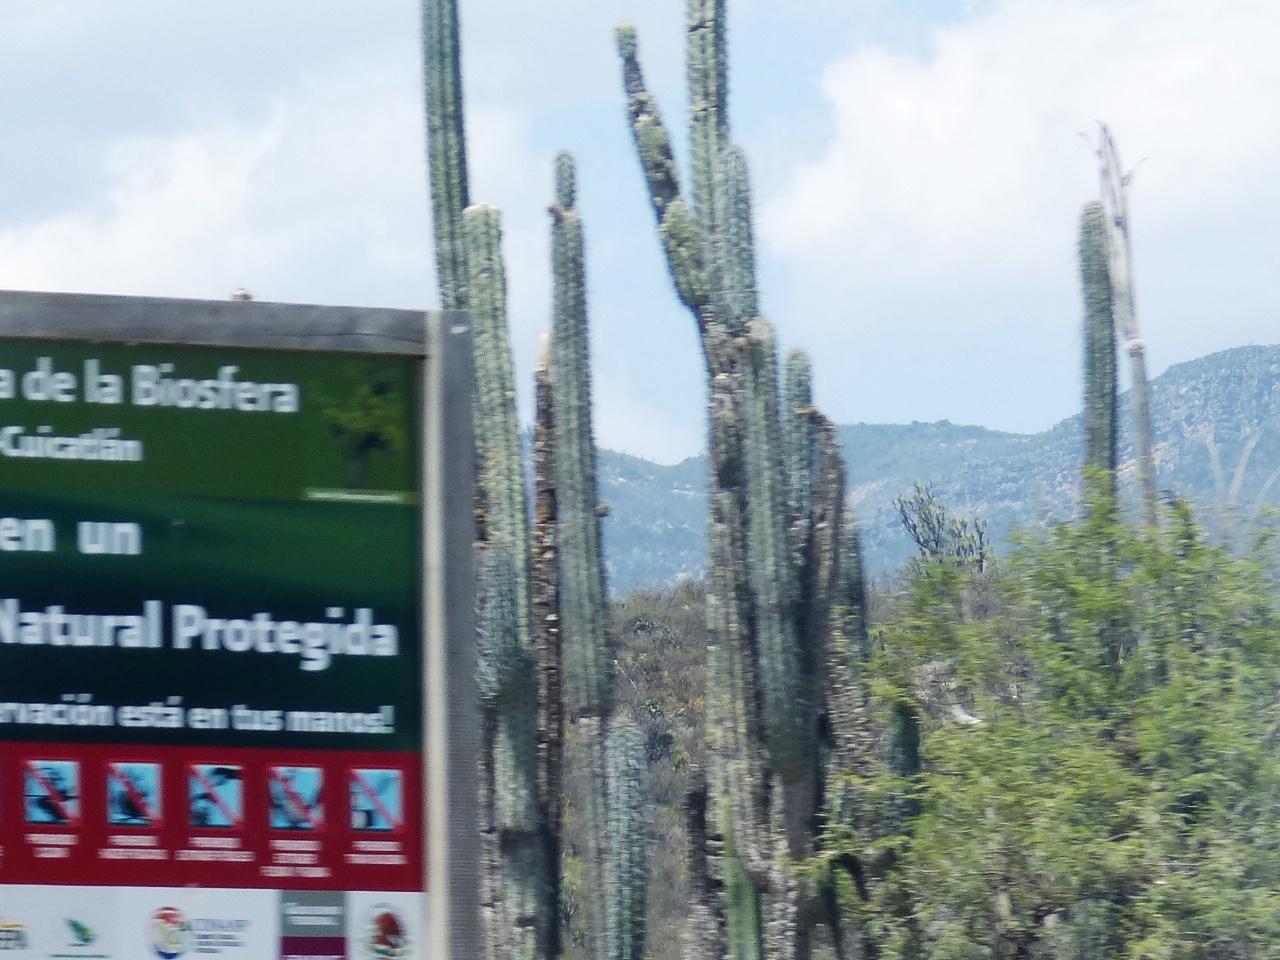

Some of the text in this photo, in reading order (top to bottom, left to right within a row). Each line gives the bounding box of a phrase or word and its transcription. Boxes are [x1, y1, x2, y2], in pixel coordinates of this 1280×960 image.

[22, 356, 78, 401] de
[82, 358, 122, 404] la
[131, 362, 300, 412] Biosfera
[77, 521, 142, 554] un
[172, 604, 399, 671] Protegida
[118, 696, 185, 728] está
[188, 708, 230, 730] en
[231, 705, 284, 731] tus
[285, 705, 395, 734] manos!
